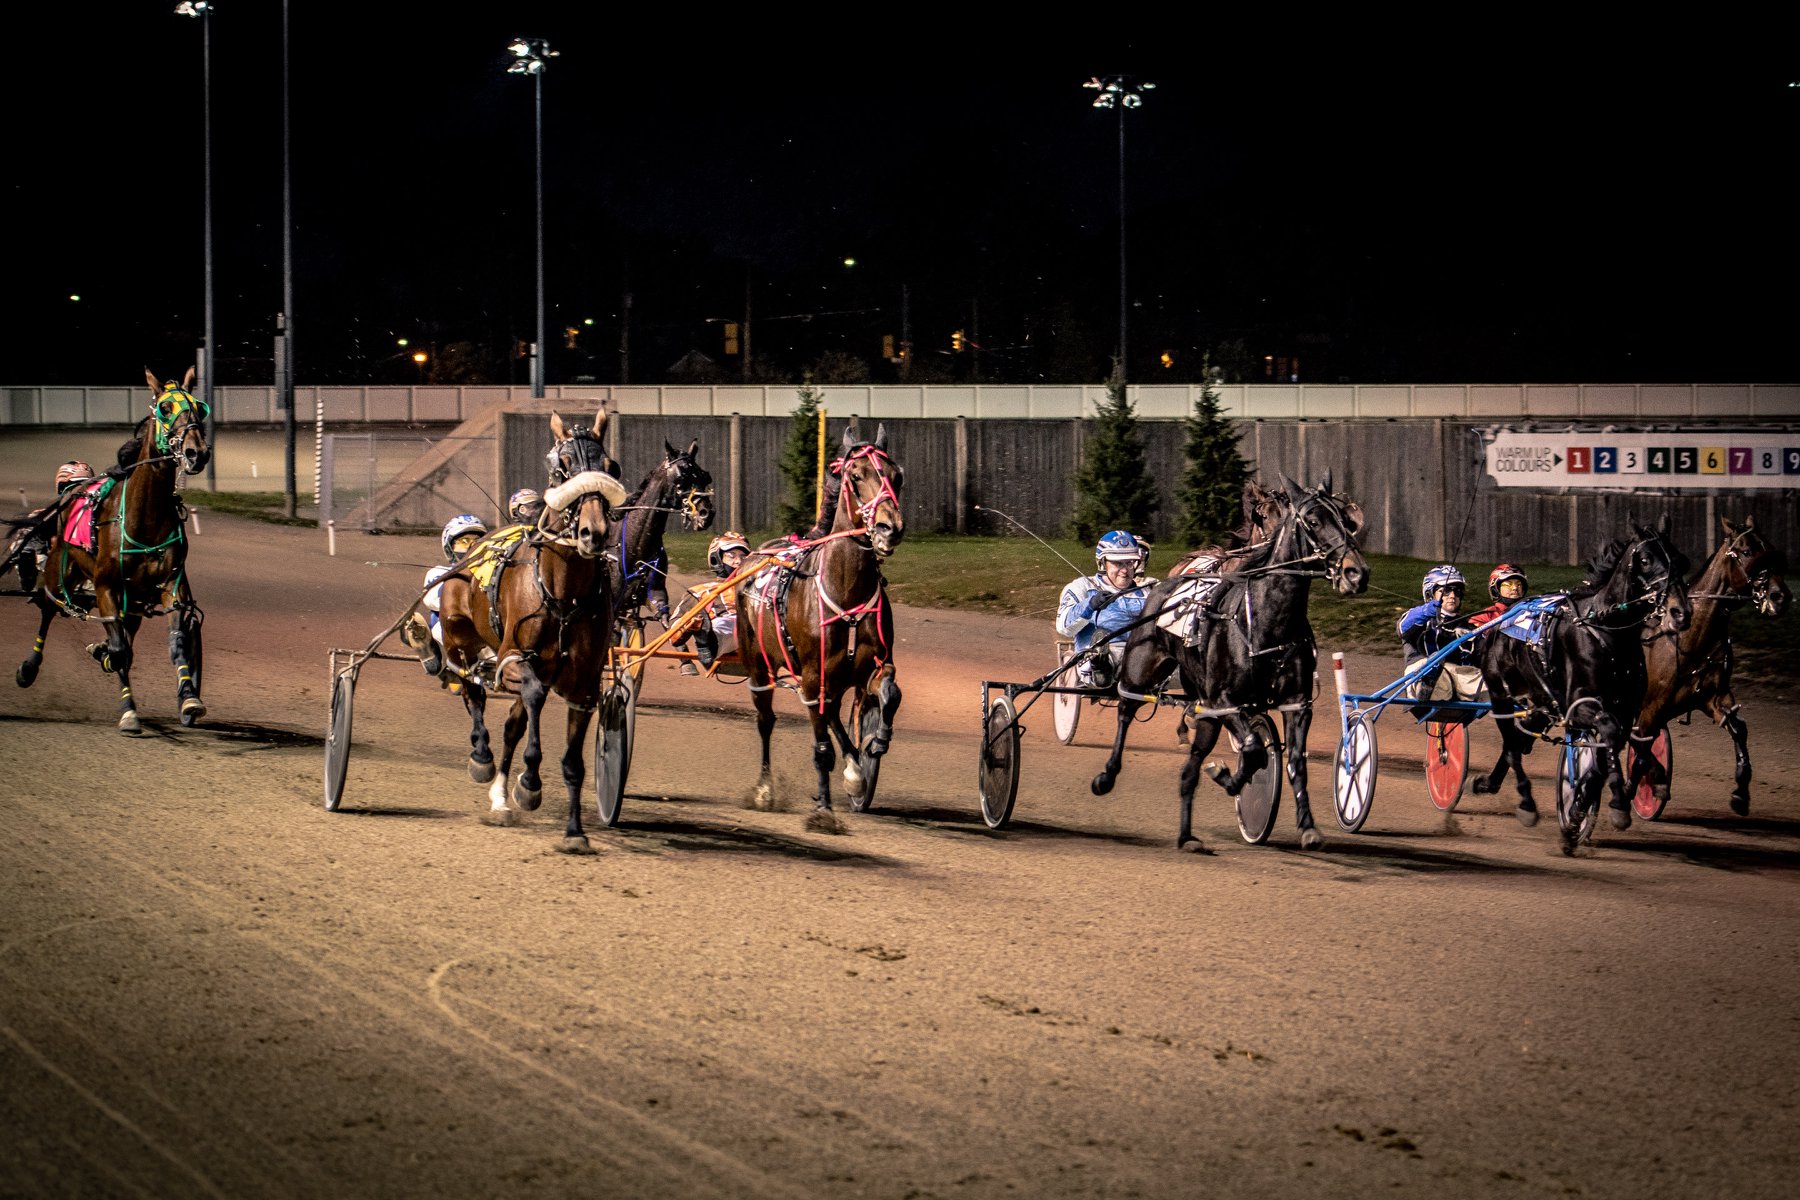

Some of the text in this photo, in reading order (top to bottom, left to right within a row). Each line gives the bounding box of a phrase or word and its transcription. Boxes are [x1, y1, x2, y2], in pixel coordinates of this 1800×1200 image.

[1495, 447, 1551, 458] WARM UP
[1495, 459, 1552, 472] COLOURS
[1572, 452, 1800, 470] 1 2 3 4 5 6 7 8 9
